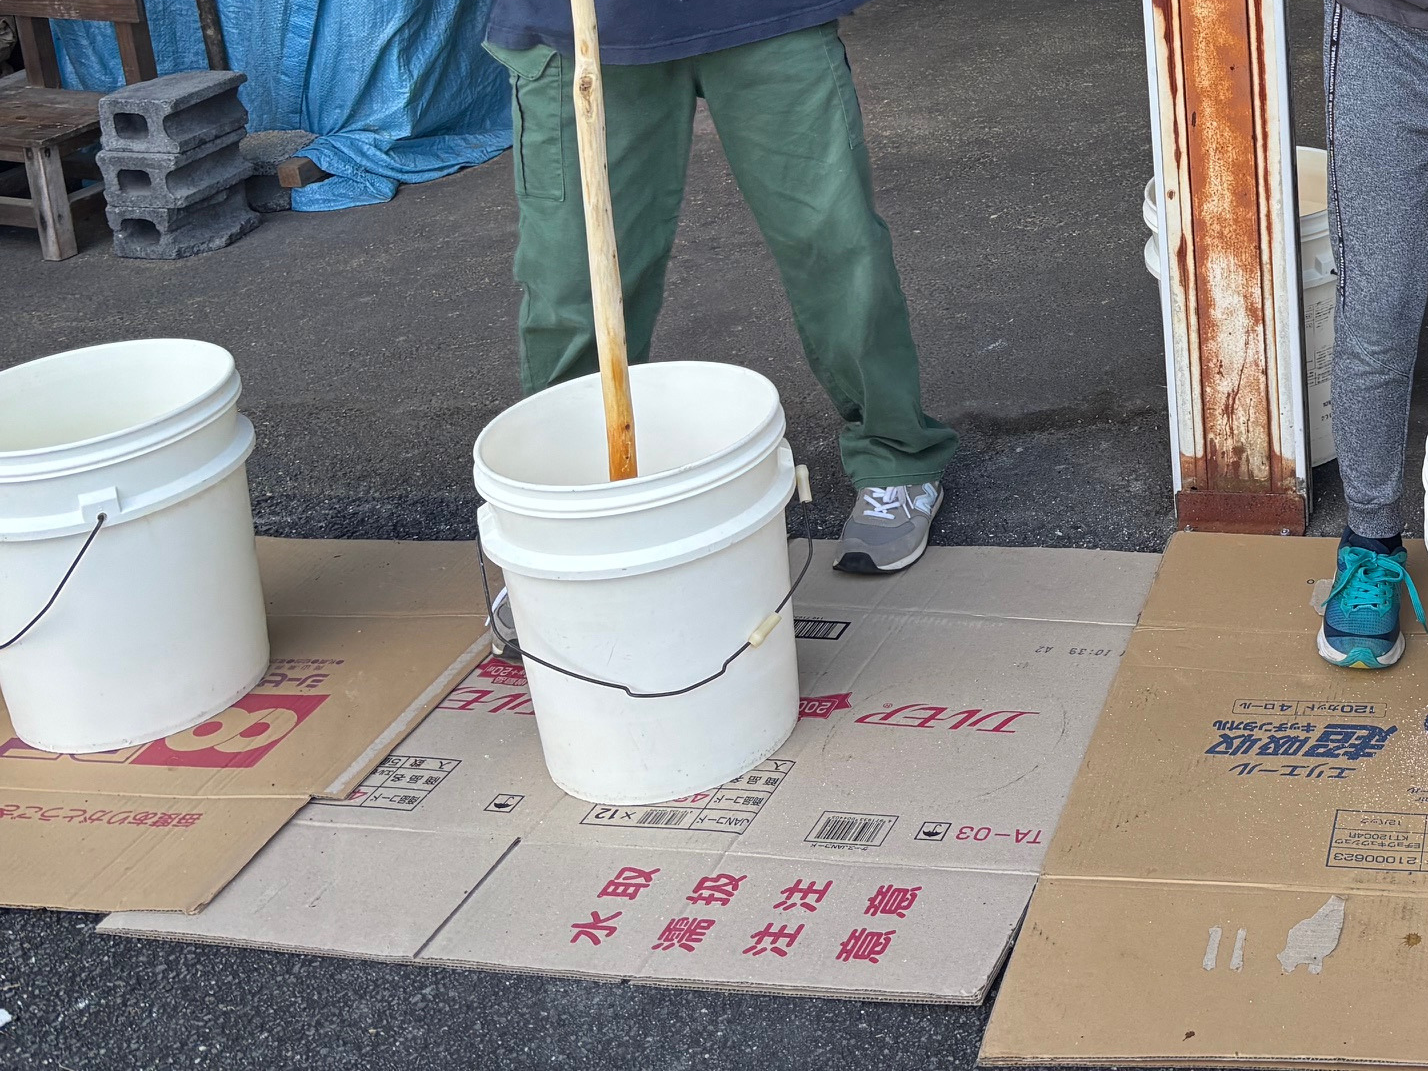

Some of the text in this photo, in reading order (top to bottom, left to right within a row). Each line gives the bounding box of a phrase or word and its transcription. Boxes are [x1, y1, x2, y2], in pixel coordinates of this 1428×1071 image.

[1069, 647, 1111, 656] 10:39
[1305, 703, 1377, 715] 120カット
[1212, 720, 1317, 734] キッチンタオル
[1204, 723, 1398, 761] 超吸収
[1228, 762, 1356, 779] エリエール
[369, 792, 420, 805] 商品コード
[713, 794, 764, 807] 商品コード
[696, 814, 750, 826] JANコード
[955, 826, 1043, 844] TA-03
[1333, 852, 1418, 865] 21000623
